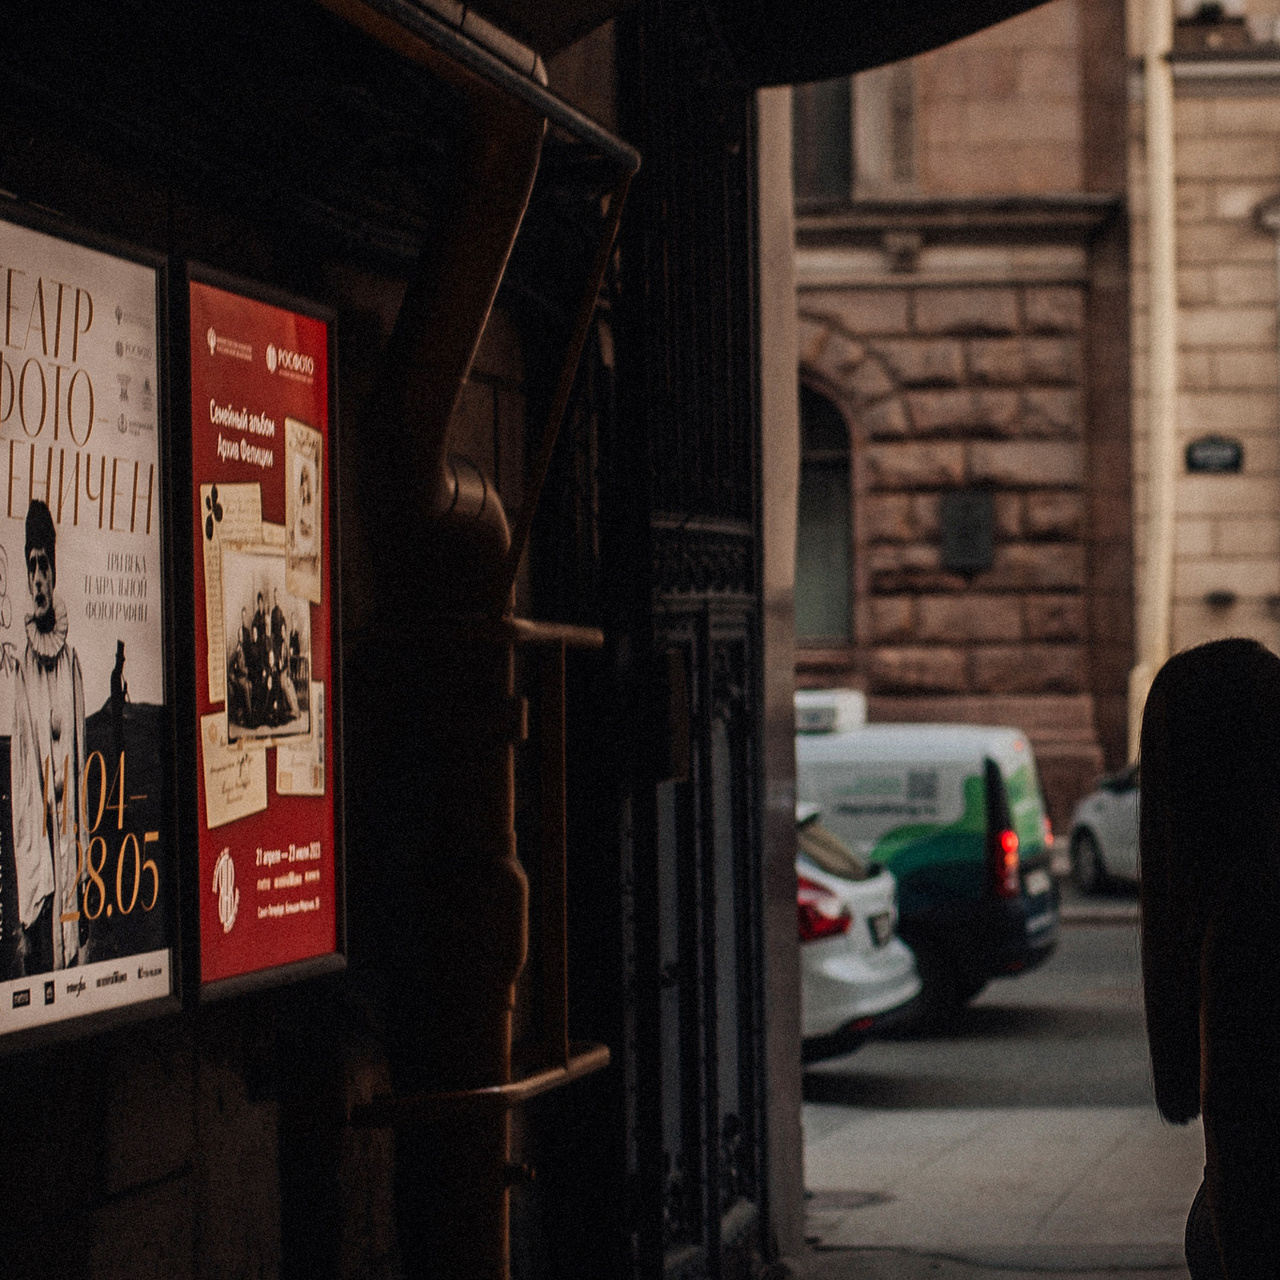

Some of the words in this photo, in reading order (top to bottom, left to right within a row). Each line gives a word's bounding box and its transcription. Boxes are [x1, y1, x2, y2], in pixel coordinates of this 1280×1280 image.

[0, 265, 94, 363] ЕАТР
[217, 432, 239, 463] Архив
[249, 411, 275, 438] альбом
[0, 437, 154, 535] ЕНИЧЕН
[60, 831, 160, 923] 28.05
